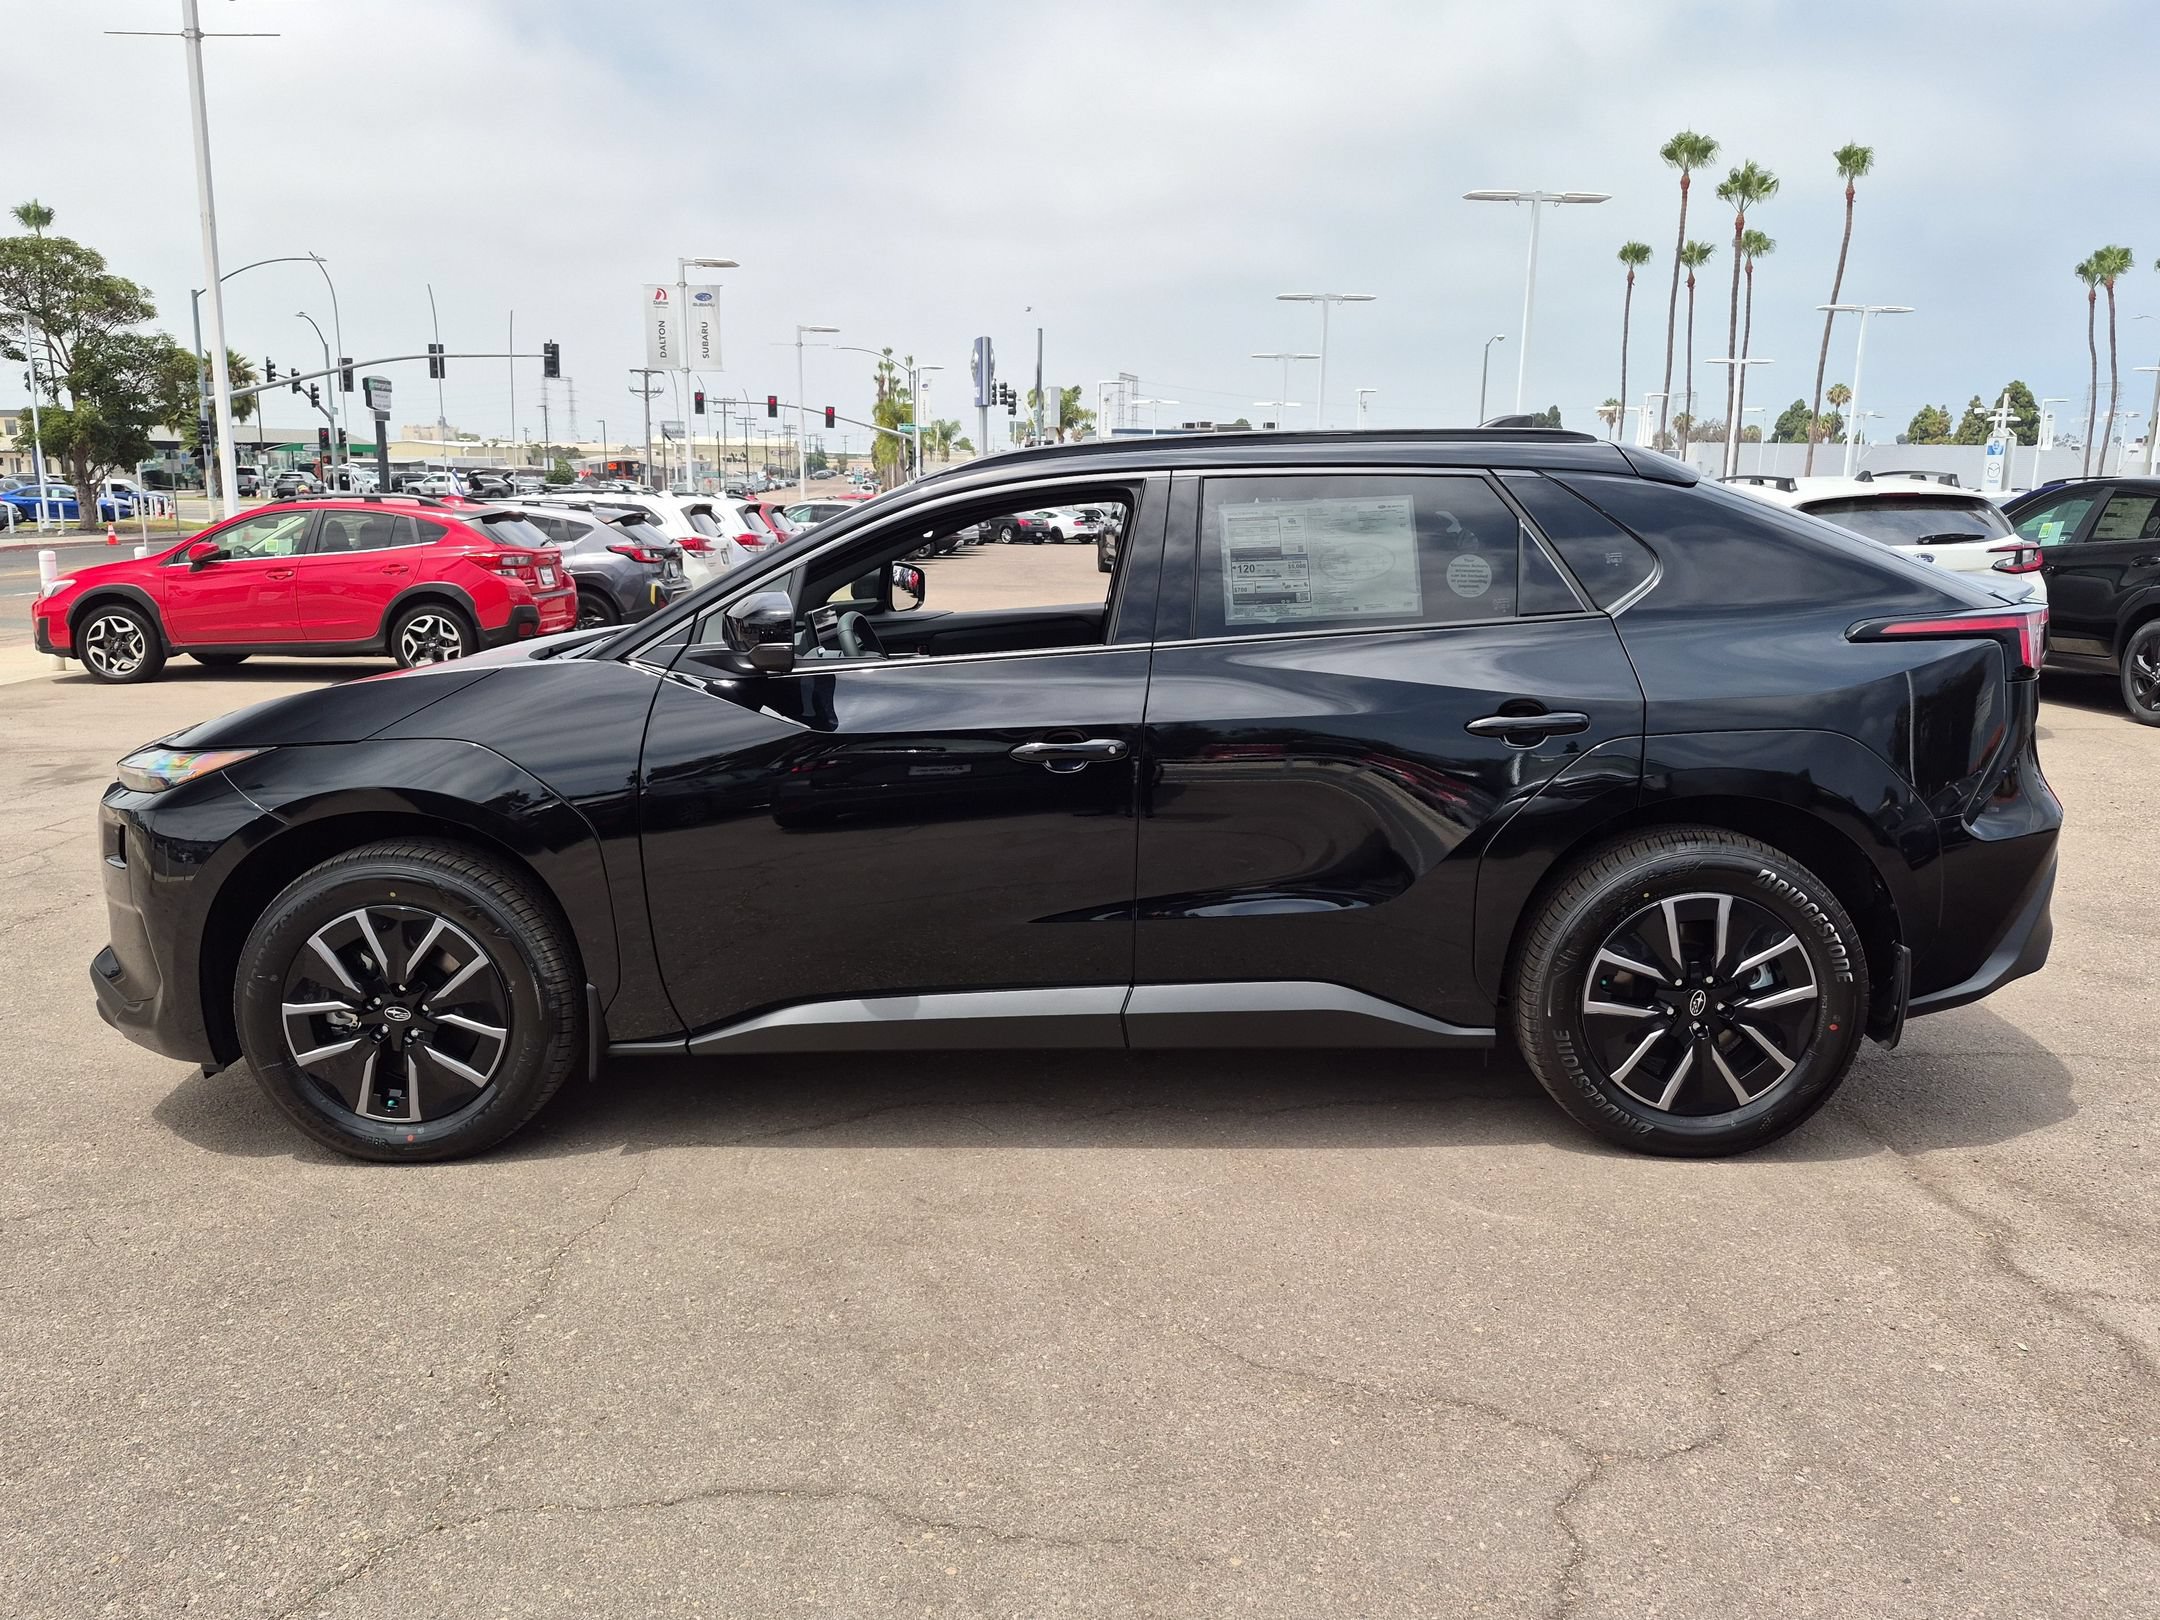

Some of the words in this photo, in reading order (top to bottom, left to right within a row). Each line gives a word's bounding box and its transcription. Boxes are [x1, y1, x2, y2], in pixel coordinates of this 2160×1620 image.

[658, 320, 667, 358] DALTON
[701, 321, 710, 359] SUBARU
[1237, 564, 1255, 574] 120
[1756, 869, 1853, 983] BRIDGESTONE
[1555, 1029, 1655, 1136] BRIDGESTONE
